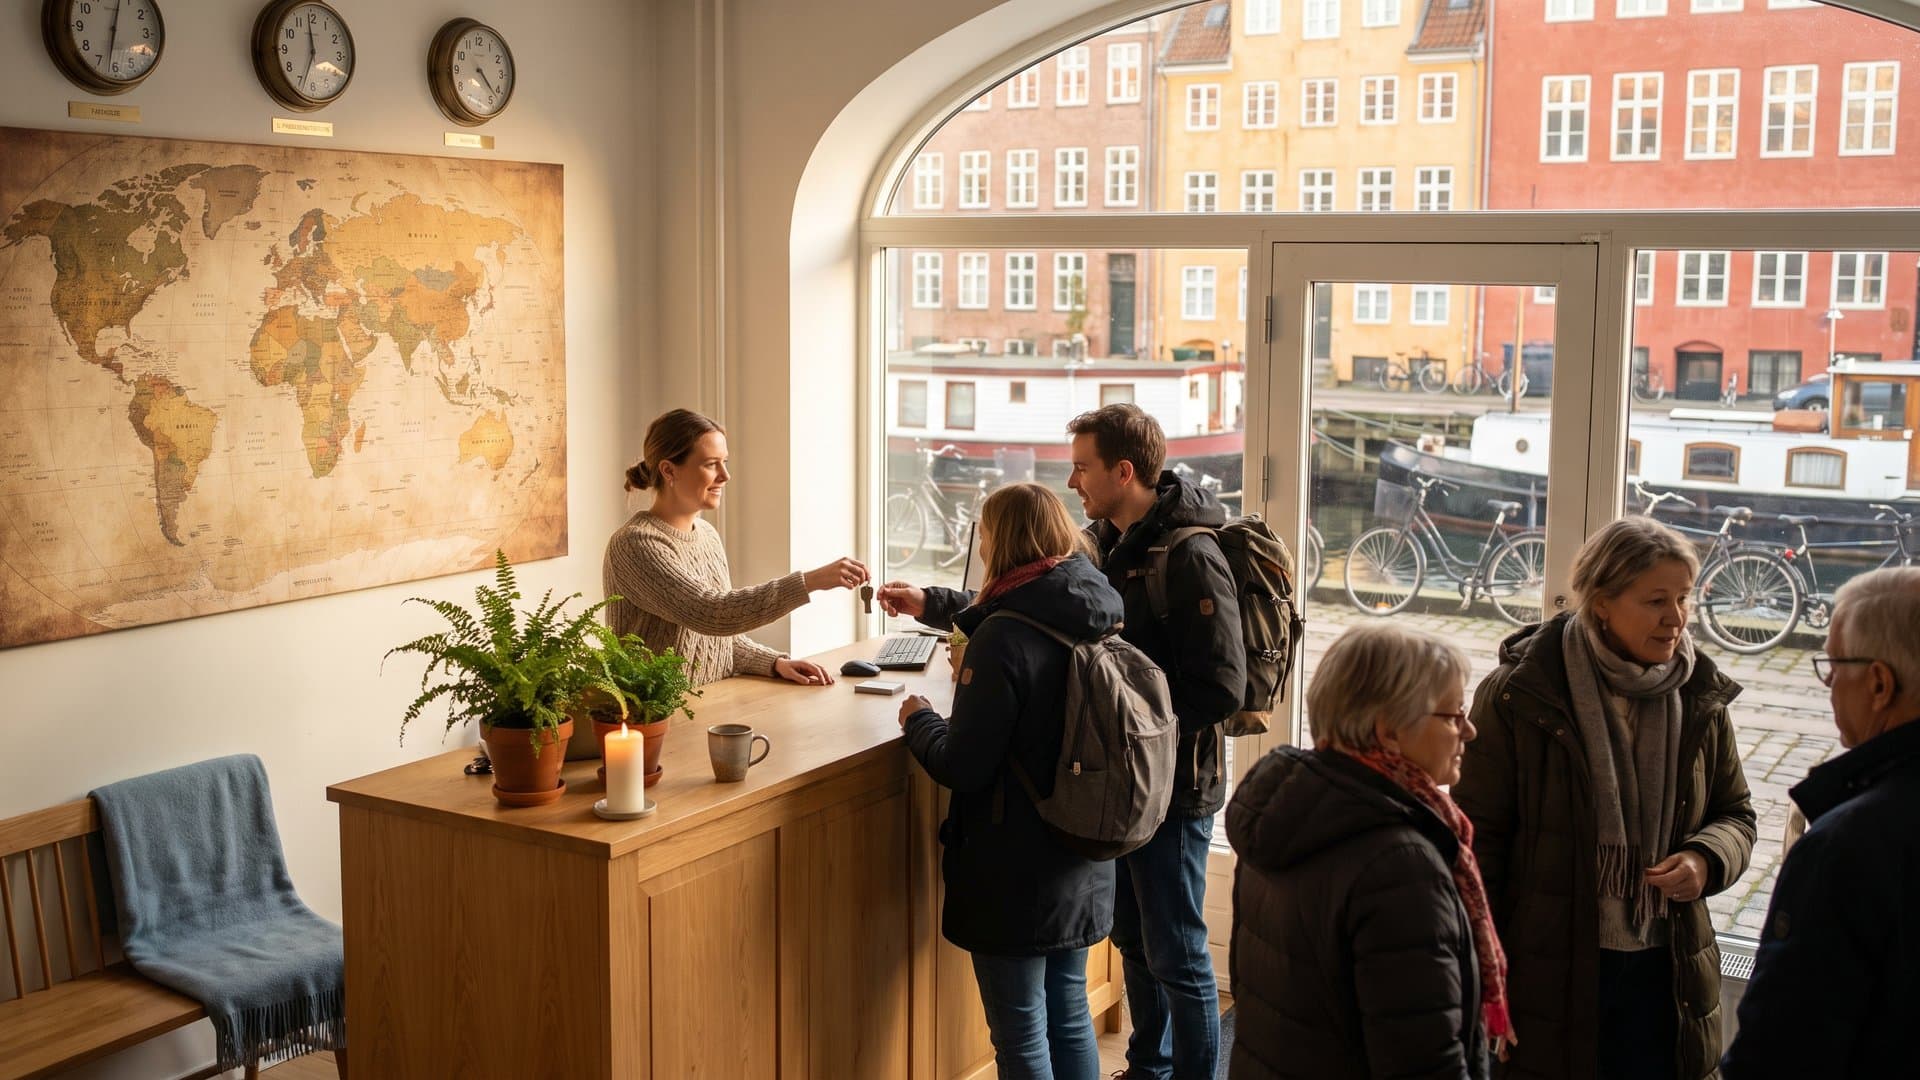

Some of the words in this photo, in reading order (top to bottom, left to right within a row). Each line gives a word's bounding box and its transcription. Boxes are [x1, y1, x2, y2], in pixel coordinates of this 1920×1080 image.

[80, 3, 91, 14] 10
[137, 9, 145, 20] 2
[75, 20, 84, 32] 9
[295, 16, 302, 28] 11
[142, 28, 150, 39] 3
[285, 28, 295, 39] 10
[332, 34, 339, 44] 2
[82, 39, 90, 51] 8
[465, 39, 471, 50] 11
[475, 36, 483, 47] 12
[281, 44, 288, 55] 9
[95, 54, 103, 66] 7
[336, 51, 342, 62] 3
[457, 50, 465, 61] 10
[495, 54, 501, 64] 2
[112, 62, 119, 73] 6
[128, 58, 135, 69] 5
[286, 61, 293, 72] 8
[454, 64, 460, 75] 9
[498, 70, 504, 80] 3
[297, 75, 303, 87] 7
[458, 81, 464, 92] 8
[310, 82, 316, 92] 6
[495, 85, 501, 94] 4
[487, 95, 493, 105] 5
